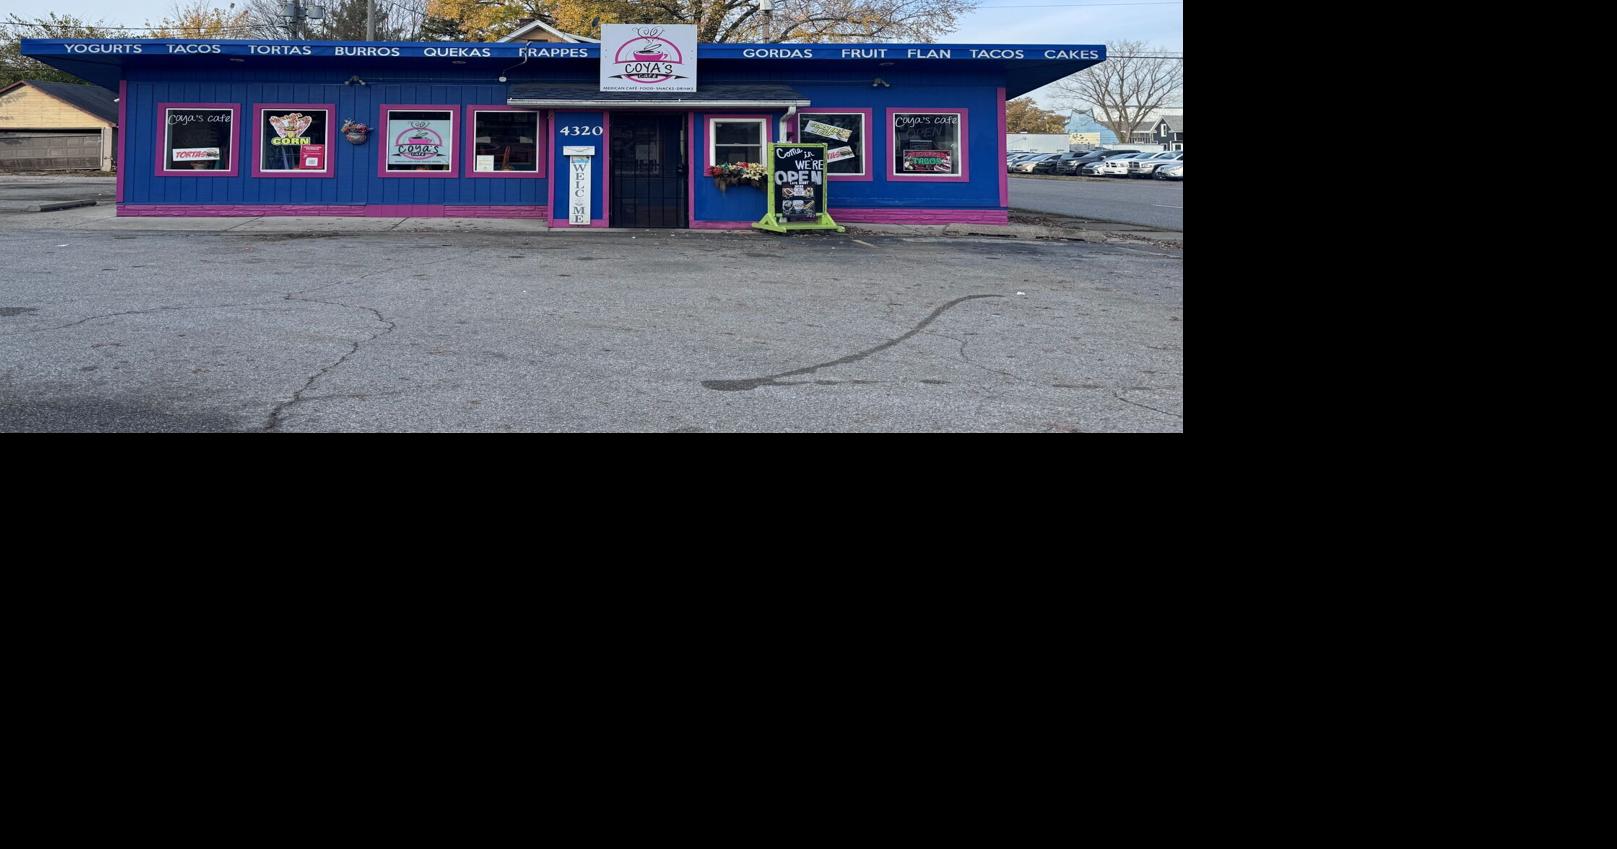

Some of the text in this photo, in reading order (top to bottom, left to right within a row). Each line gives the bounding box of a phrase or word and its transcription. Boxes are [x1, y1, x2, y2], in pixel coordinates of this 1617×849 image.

[64, 44, 588, 58] YOGURTS TACOS TORTAS BURROS QUEKAS FRAPPES
[742, 48, 1099, 60] GORDAS FRUIT FLAN TACOS CAKES
[625, 62, 673, 74] COYA'S
[168, 113, 231, 126] Coya's cafe
[895, 116, 958, 128] Coya's cafe
[560, 126, 603, 136] 4320
[272, 137, 309, 145] CORN
[176, 151, 207, 159] TORTAS
[776, 148, 815, 159] Come in
[795, 159, 824, 170] WE'RE
[775, 170, 823, 185] OPEN
[573, 164, 586, 223] WELCME
